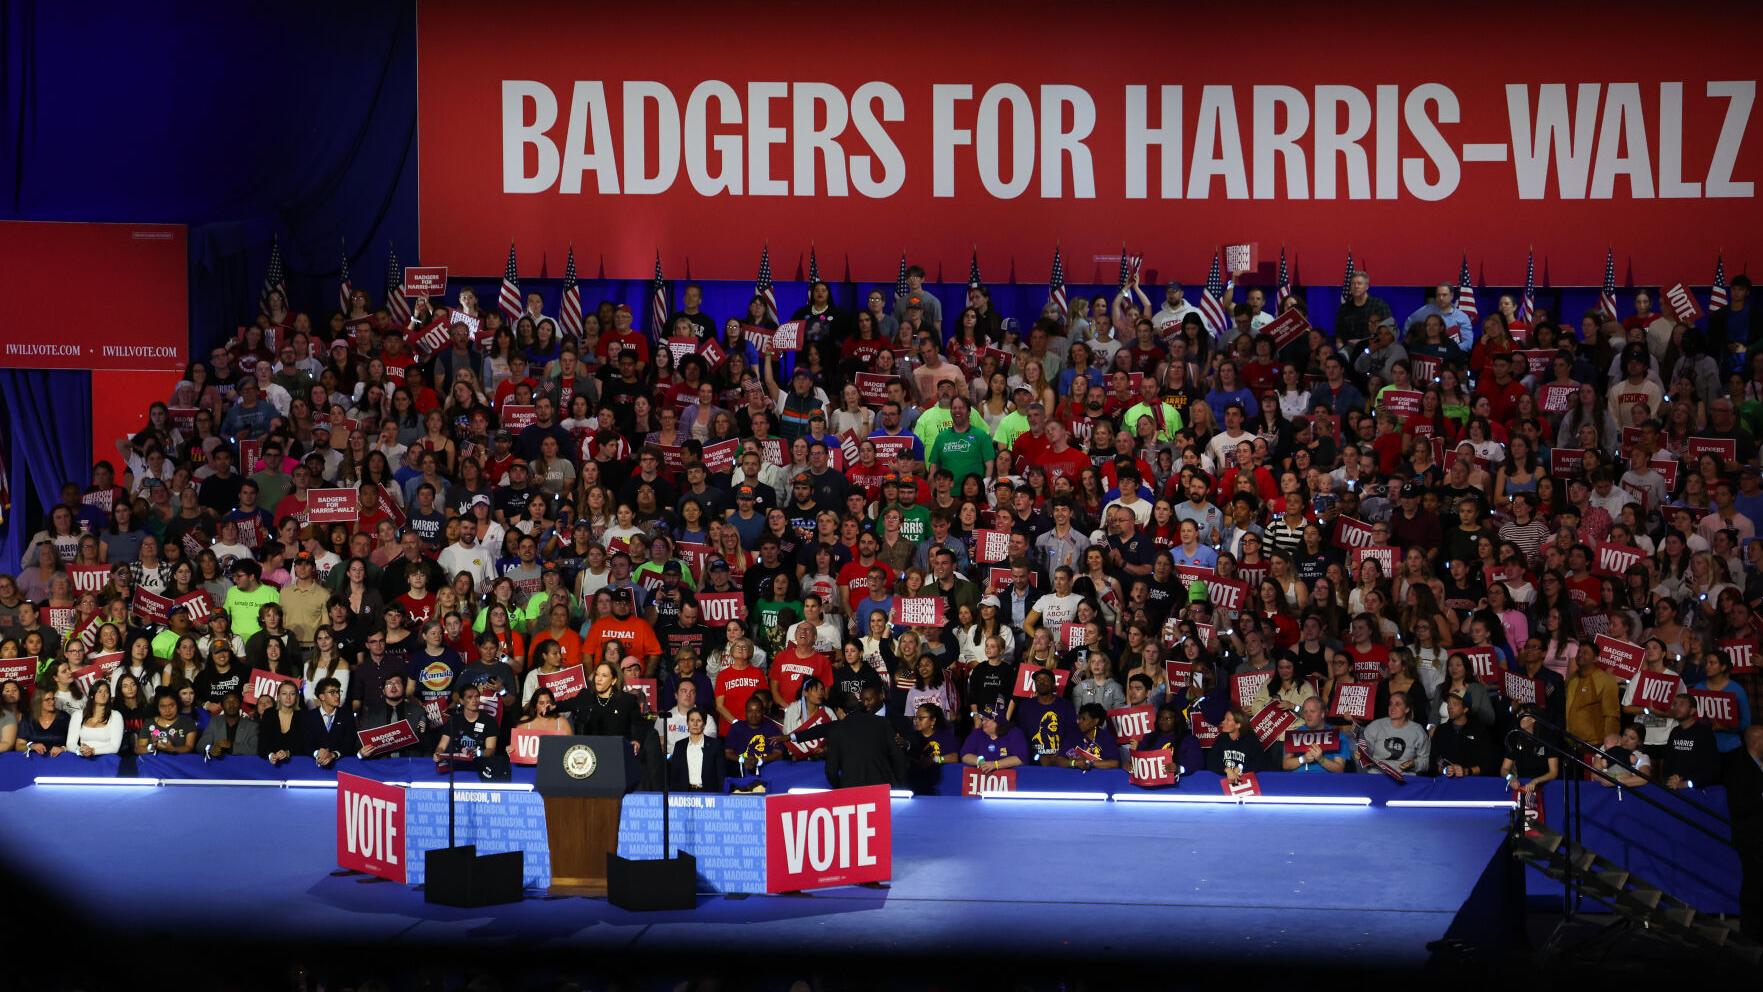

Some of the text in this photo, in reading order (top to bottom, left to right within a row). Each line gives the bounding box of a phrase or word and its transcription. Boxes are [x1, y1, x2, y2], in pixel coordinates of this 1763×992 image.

[502, 79, 906, 198] BADGERS
[932, 83, 1097, 199] FOR
[1666, 283, 1696, 321] VOTE
[416, 323, 451, 353] VOTE
[6, 344, 177, 357] IWILLVOTE.COM IWILLVOTE.COM
[705, 343, 721, 367] TE
[1546, 395, 1568, 404] FREED
[1073, 421, 1094, 439] VO
[1415, 425, 1433, 434] WISCO
[704, 448, 730, 459] BADGERS
[412, 520, 440, 531] HARRIS
[900, 523, 923, 533] ARRIS
[901, 533, 918, 541] ALZ
[54, 544, 78, 552] HARRI
[1361, 550, 1391, 559] FREEDOM
[1239, 568, 1267, 585] OTE
[644, 576, 665, 591] VO
[850, 577, 868, 588] WISCO
[140, 595, 164, 607] BADGERS
[902, 598, 935, 606] FREEDOM
[50, 609, 75, 617] FREEDO
[187, 595, 210, 621] OTE
[701, 598, 738, 620] VOTE
[901, 606, 935, 614] FREEDOM
[901, 614, 935, 624] FREEDOM
[1070, 627, 1086, 636] FREE
[1070, 635, 1086, 643] FREE
[1070, 642, 1086, 650] FREE
[1603, 646, 1632, 659] BADGERS
[1611, 654, 1623, 662] FOR
[781, 664, 814, 674] WISCONSIN
[1354, 662, 1381, 670] ISCONSI
[1470, 654, 1493, 676] OTE
[1597, 656, 1636, 672] ARRIS–WALZ
[78, 672, 96, 692] TE
[419, 670, 453, 683] Kamala
[1238, 675, 1269, 685] FREEDOM
[1505, 673, 1535, 687] FREEDOM
[254, 676, 281, 698] VOT
[546, 676, 575, 690] BADGERS
[725, 678, 759, 690] WISCONSI
[1239, 685, 1263, 696] FREED
[1341, 686, 1368, 696] FREEDOM
[1643, 678, 1675, 703] VOTE
[1240, 694, 1254, 706] FREE
[1339, 696, 1367, 705] FREEDOM
[1696, 696, 1732, 719] VOTE
[1113, 712, 1150, 737] VOTE
[371, 730, 400, 743] BADGERS
[1293, 732, 1332, 745] VOTE
[518, 736, 539, 757] VO
[1673, 740, 1694, 748] HARRIS
[1131, 756, 1166, 779] VOTE
[454, 792, 501, 803] MADISON, WI
[668, 797, 759, 808] MADISON, WI MADISON,
[724, 810, 735, 819] WI
[344, 790, 398, 865] VOTE
[490, 817, 537, 827] MADISON, WI
[630, 820, 640, 830] WI
[705, 822, 753, 832] MADISON, WI
[620, 832, 659, 843] ADISON, WI
[723, 834, 758, 844] MADISON,
[780, 802, 877, 874] VOTE
[705, 859, 754, 869] MADISON, WI
[724, 870, 760, 881] MADISON,
